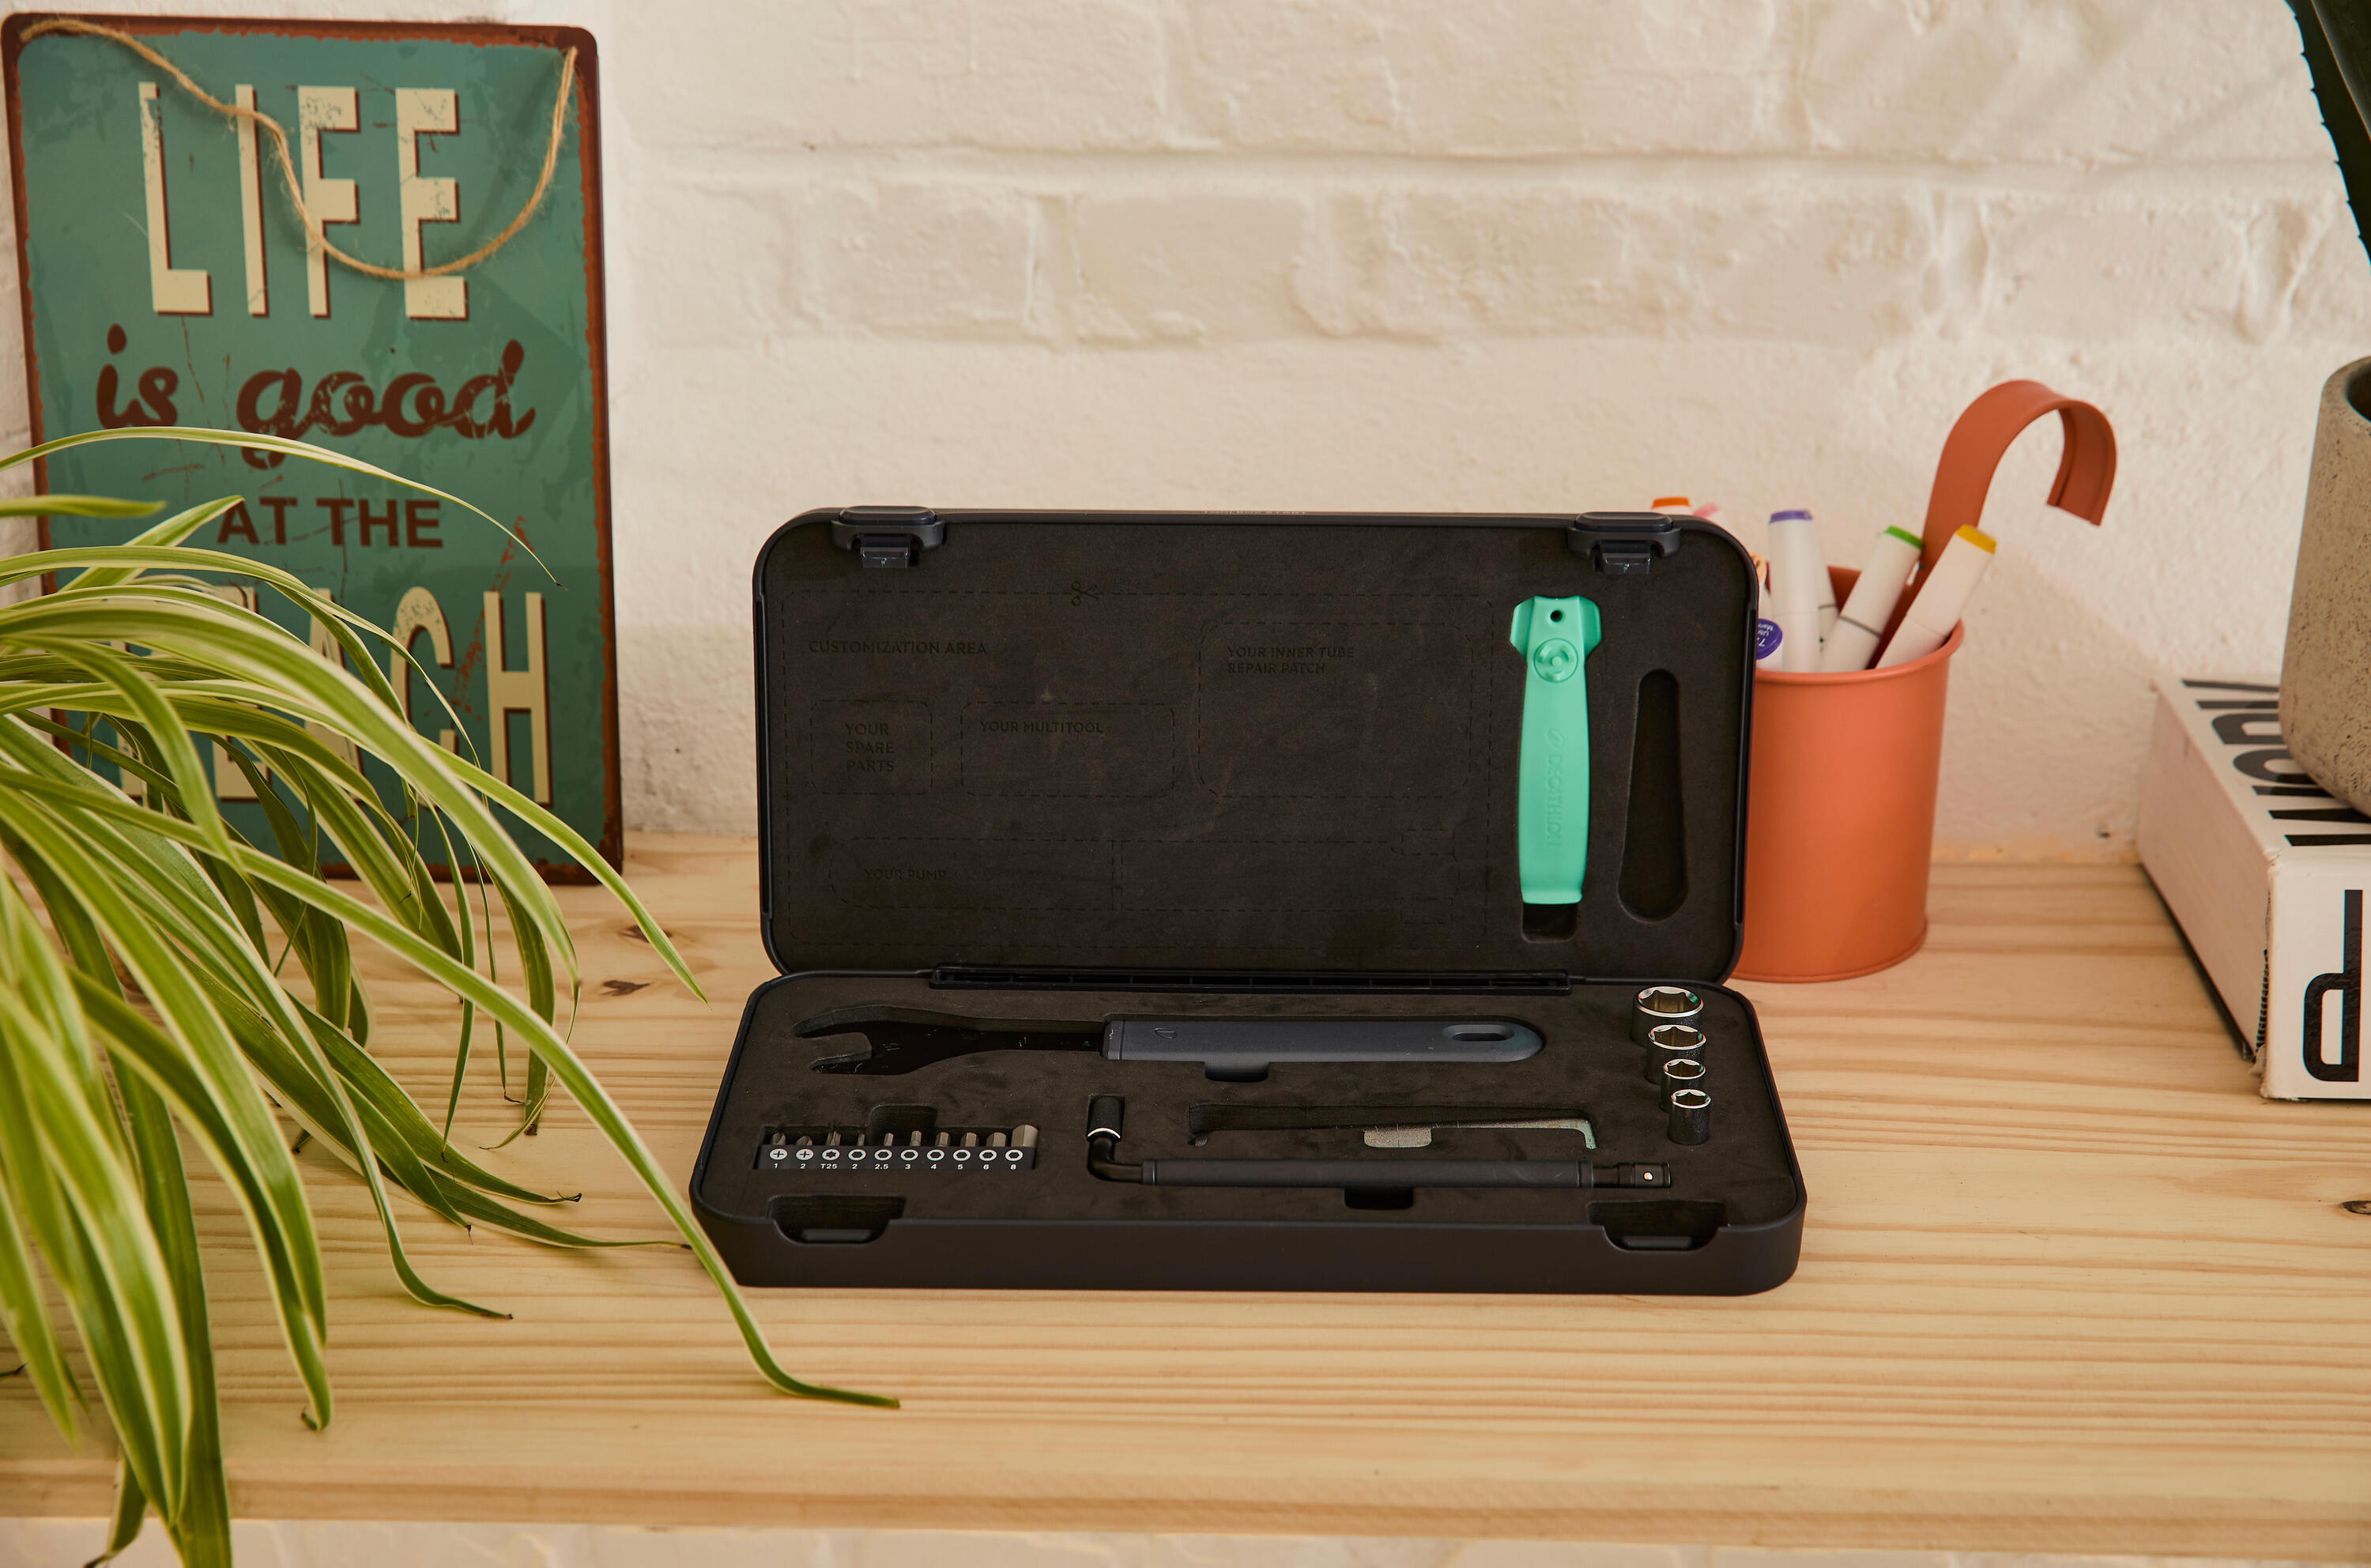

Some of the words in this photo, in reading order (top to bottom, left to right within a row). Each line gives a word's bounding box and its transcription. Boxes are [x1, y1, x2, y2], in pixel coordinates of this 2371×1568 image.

[138, 82, 468, 320] LIFE
[96, 324, 180, 430] is
[236, 340, 536, 469] good
[217, 496, 298, 546] AT
[316, 497, 444, 548] THE
[809, 640, 939, 654] CUSTOMIZATION
[945, 642, 987, 654] AREA
[1227, 646, 1266, 658] YOUR
[1271, 647, 1314, 658] INNER
[1318, 647, 1355, 658] TUBE
[1227, 662, 1276, 673] REPAIR
[1281, 662, 1325, 673] PATCH
[845, 722, 889, 735] YOUR
[980, 721, 1019, 732] YOUR
[1023, 722, 1104, 733] MULTITOOL
[846, 740, 895, 754] SPARE
[846, 759, 895, 772] PARTS
[1546, 753, 1563, 848] DECATHLON
[864, 868, 903, 880] YOUR
[907, 869, 947, 880] PUMP
